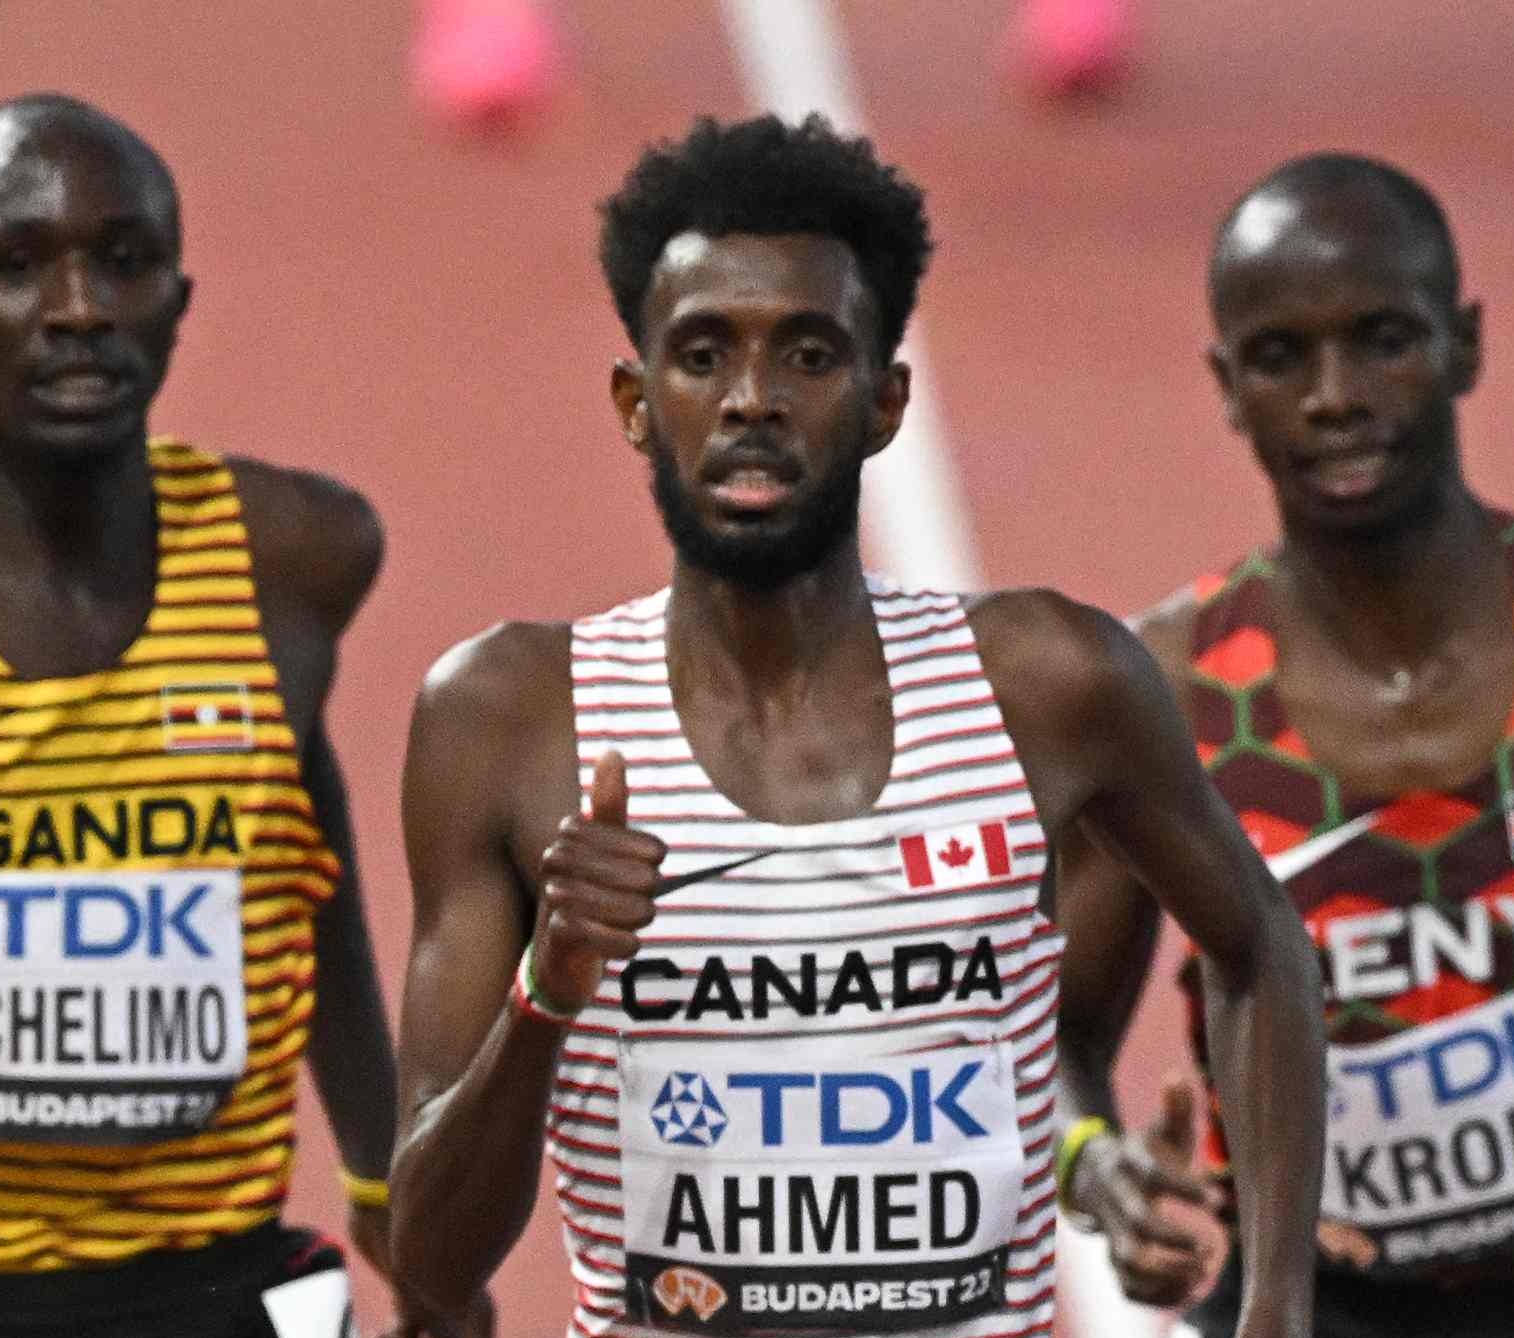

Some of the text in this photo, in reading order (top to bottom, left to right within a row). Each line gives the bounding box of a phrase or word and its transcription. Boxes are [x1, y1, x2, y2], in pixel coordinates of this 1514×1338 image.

[0, 797, 241, 868] ANDA
[0, 884, 213, 959] TDK
[620, 936, 1002, 1020] CANADA
[0, 985, 227, 1065] HELIMO
[727, 1061, 990, 1147] TDK
[663, 1170, 980, 1254] AHMED
[741, 1268, 992, 1313] BUDAPEST 23
